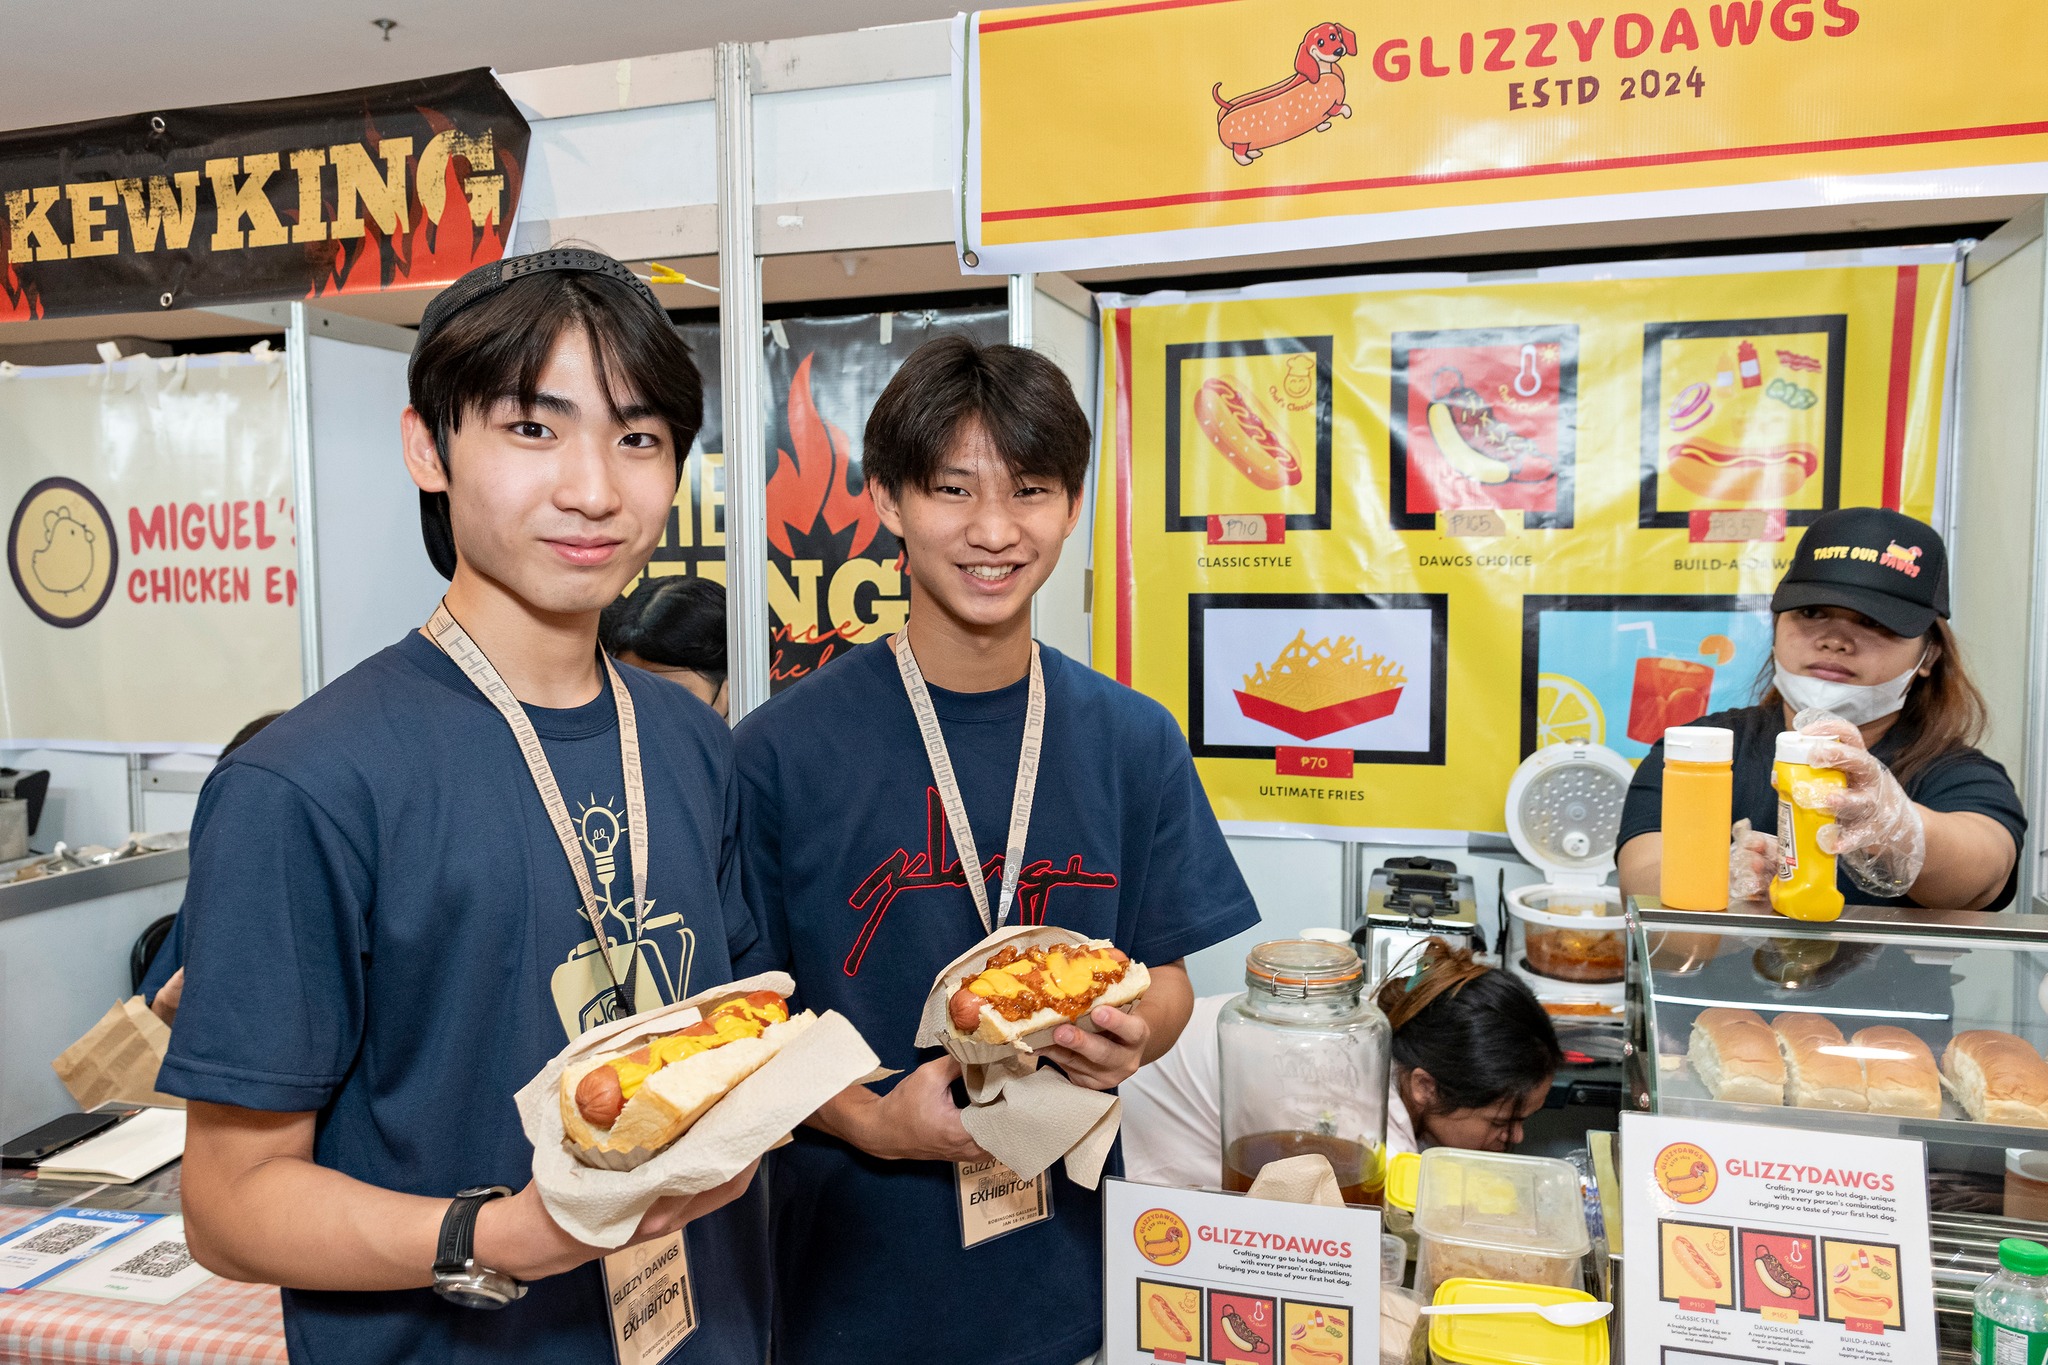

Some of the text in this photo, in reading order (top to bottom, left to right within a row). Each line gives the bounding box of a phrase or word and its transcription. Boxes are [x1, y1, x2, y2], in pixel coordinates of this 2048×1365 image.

[1372, 0, 1861, 82] GLIZZYDAWGS
[1508, 66, 1706, 111] ESTD 2024
[657, 453, 727, 547] HE
[1197, 556, 1292, 567] CLASSIC STYLE
[1419, 555, 1533, 567] DAWGS CHOICE
[1813, 546, 1921, 578] TASTE OUR DAWGS
[128, 566, 249, 604] CHICKEN
[1259, 785, 1365, 801] ULTIMATE FRIES
[962, 1158, 997, 1176] GLIZZY
[1725, 1158, 1896, 1192] GLIZZYDAWGS
[970, 1179, 1034, 1206] EXHIBITOR
[1765, 1183, 1795, 1193] Crafting
[1796, 1187, 1813, 1195] your
[1835, 1190, 1848, 1198] hot
[1849, 1192, 1869, 1201] dogs,
[1870, 1195, 1896, 1203] unique
[1773, 1193, 1897, 1213] with every person's combinations,
[101, 1209, 140, 1221] GCash
[1749, 1200, 1780, 1210] bringing
[1802, 1205, 1821, 1213] taste
[1831, 1209, 1849, 1217] your
[1850, 1209, 1865, 1218] first
[1866, 1211, 1879, 1219] hot
[1880, 1213, 1898, 1222] dog.
[1197, 1225, 1353, 1259] GLIZZYDAWGS
[1233, 1249, 1260, 1259] Crafting
[1261, 1253, 1277, 1261] your
[1297, 1256, 1308, 1264] hot
[1309, 1258, 1328, 1267] dogs,
[1328, 1261, 1353, 1269] unique
[1256, 1261, 1275, 1269] every
[1276, 1264, 1304, 1272] person's
[1305, 1267, 1352, 1278] combinations,
[613, 1272, 643, 1306] GLIZZY
[645, 1244, 679, 1279] DAWGS
[1217, 1263, 1246, 1274] bringing
[1266, 1269, 1282, 1277] taste
[1323, 1276, 1336, 1284] hot
[1336, 1278, 1353, 1287] dog.
[623, 1282, 680, 1342] EXHIBITOR
[1674, 1314, 1719, 1325] CLASSIC STYLE
[1754, 1324, 1804, 1335] DAWGS CHOICE
